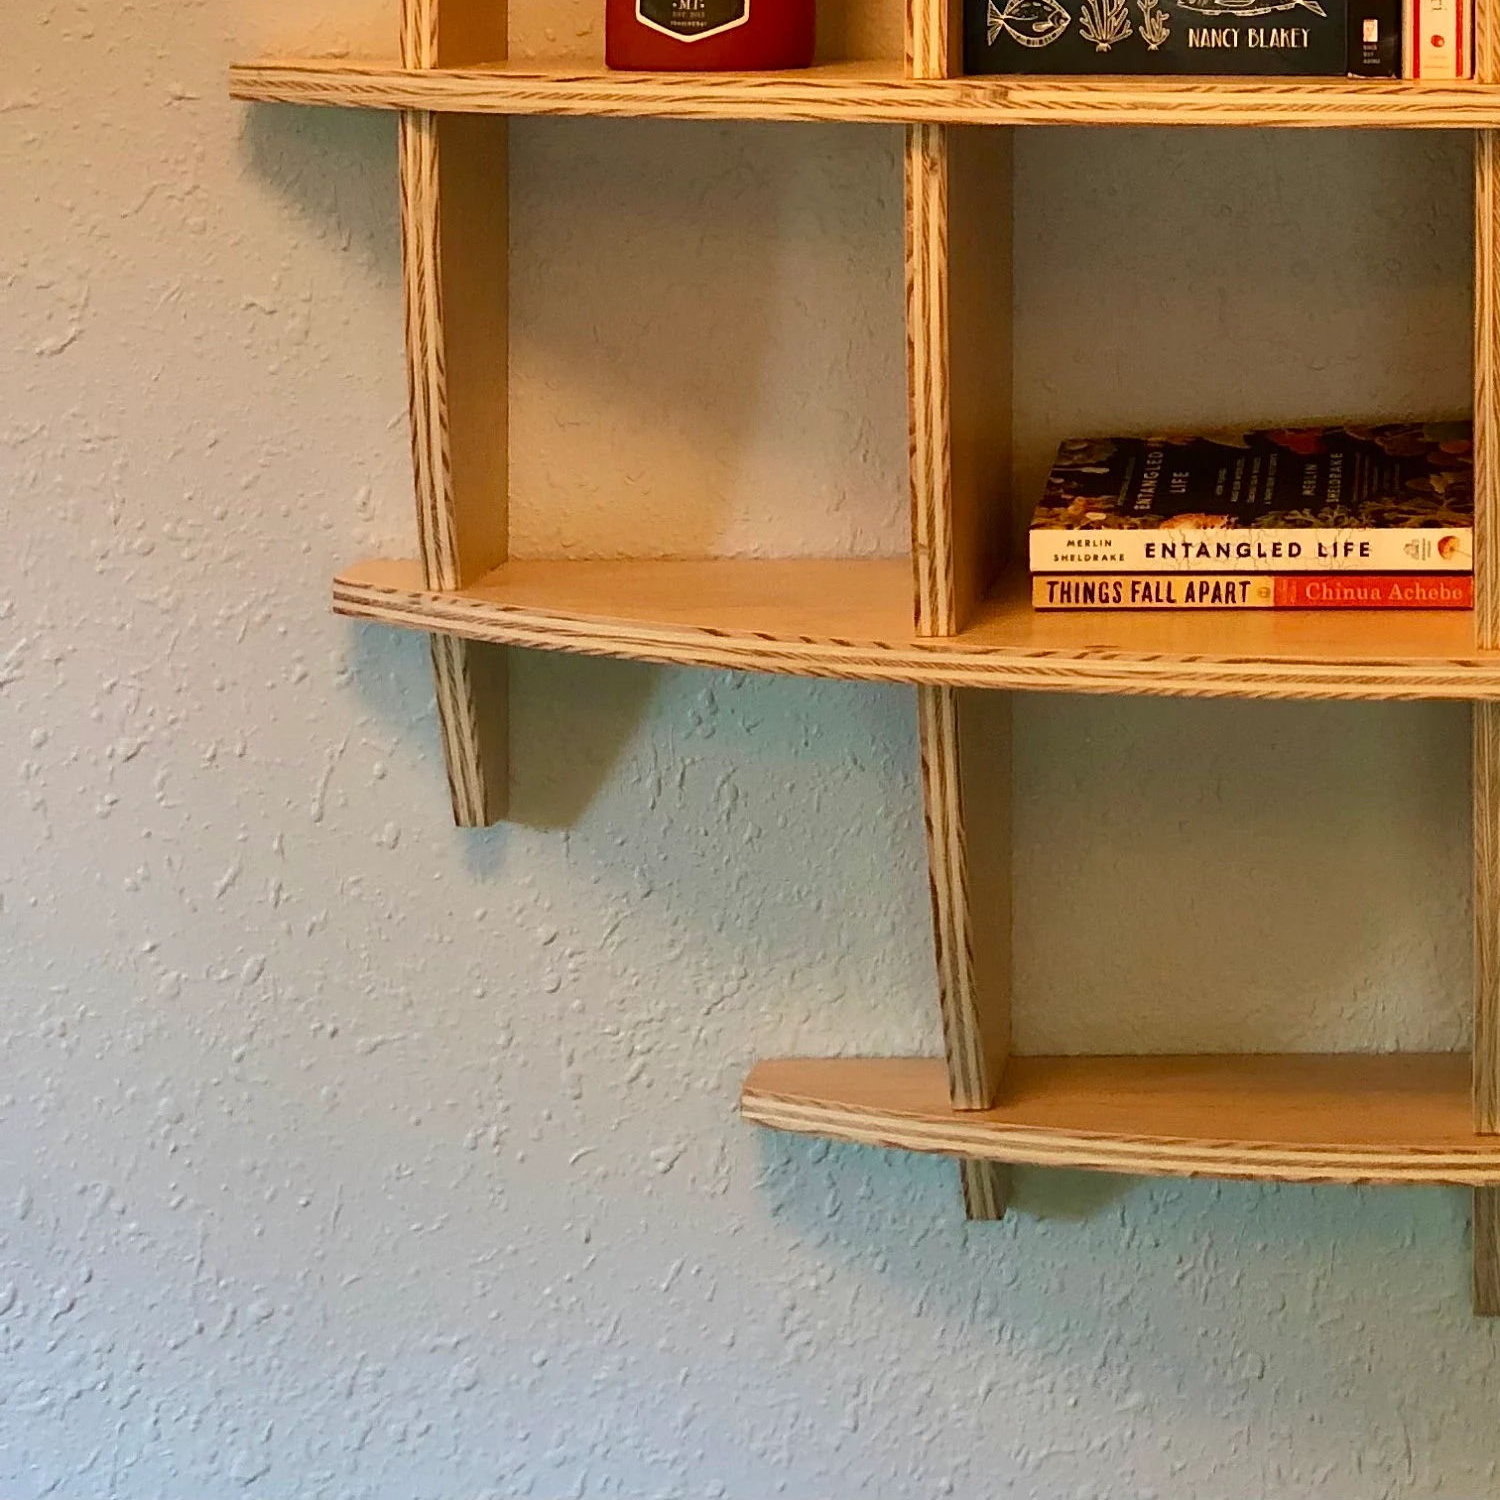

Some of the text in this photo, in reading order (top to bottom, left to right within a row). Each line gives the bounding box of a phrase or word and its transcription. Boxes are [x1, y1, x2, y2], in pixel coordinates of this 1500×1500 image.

[1188, 27, 1313, 49] NANCY BLAKEY
[1133, 450, 1164, 511] ENTANGLED
[1169, 470, 1190, 494] LIFE
[1301, 463, 1318, 496] MERLIN
[1326, 451, 1344, 503] SHELDRAKE
[1066, 539, 1113, 548] MERLIN
[1144, 541, 1371, 559] ENTANGLED LIFE
[1053, 553, 1126, 563] SHELDRAKE
[1046, 580, 1252, 605] THINGS FALL APART
[1305, 581, 1465, 601] Chinua Achebe
